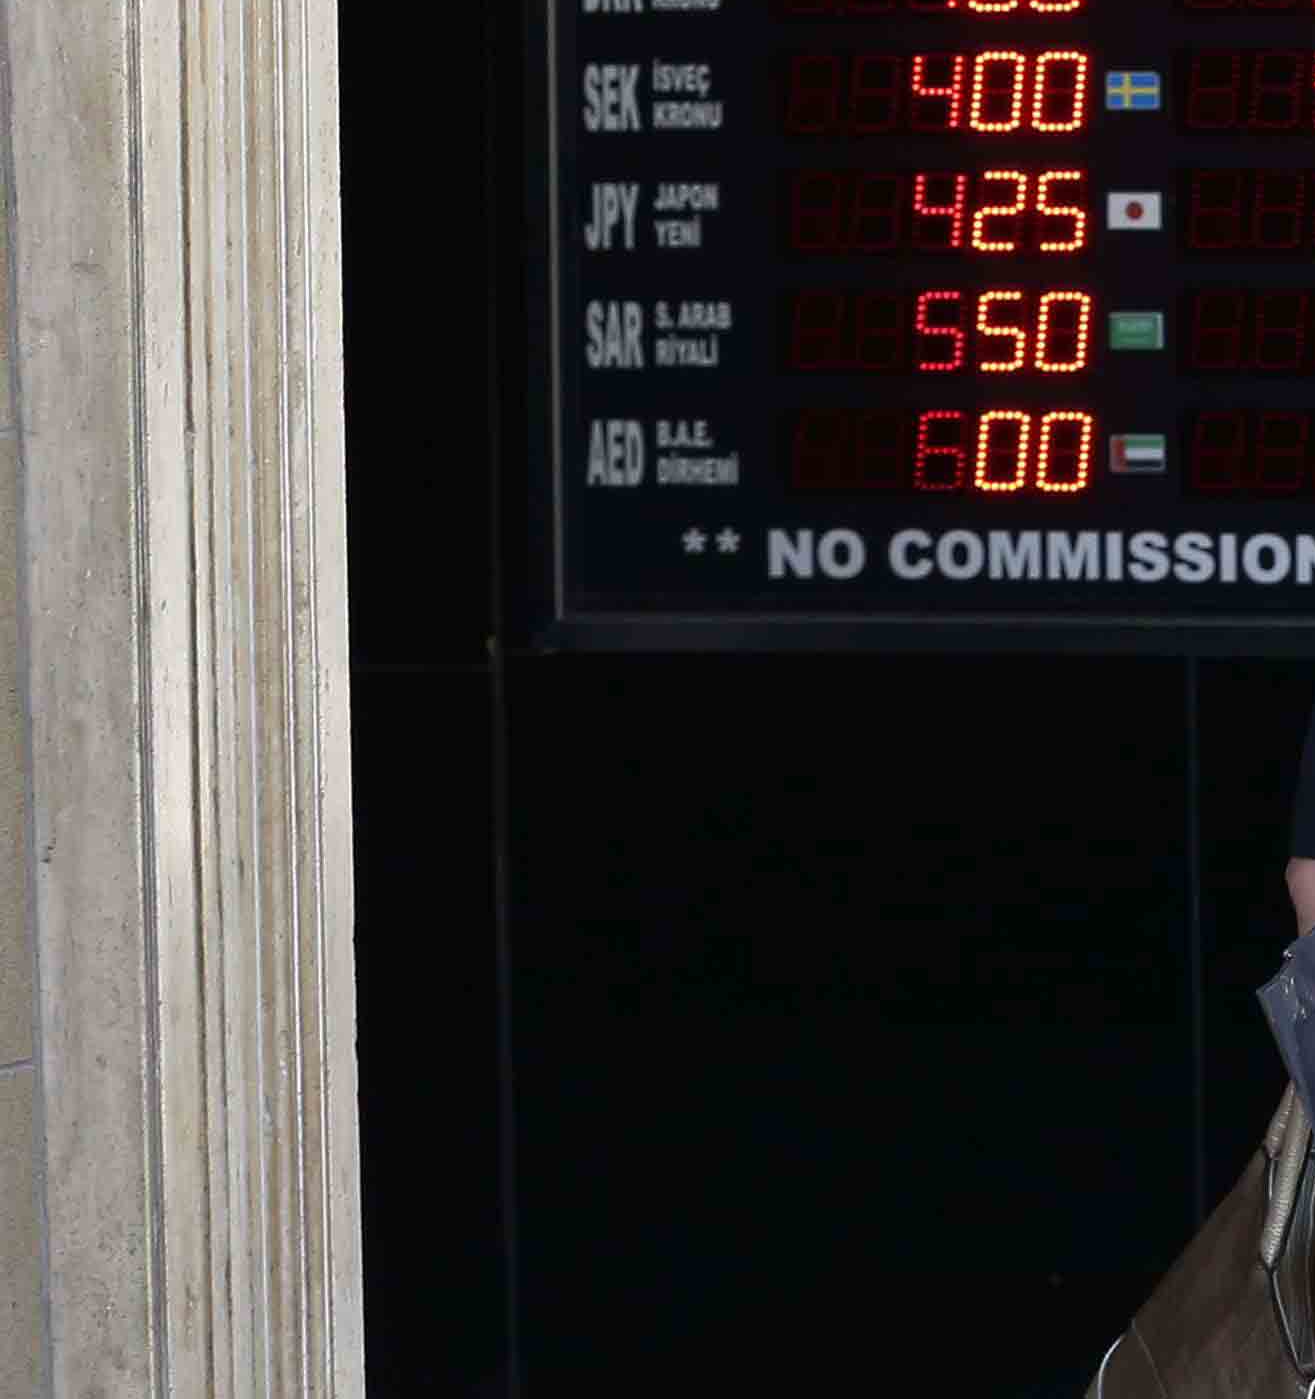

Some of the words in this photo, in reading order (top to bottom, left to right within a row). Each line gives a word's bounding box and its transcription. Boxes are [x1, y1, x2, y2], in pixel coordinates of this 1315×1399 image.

[583, 63, 641, 132] SEK
[652, 60, 710, 97] İSVEÇ
[911, 50, 1089, 133] 400
[652, 101, 723, 129] KRONU
[584, 182, 639, 250] JPY
[653, 183, 719, 211] JAPON
[913, 169, 1088, 252] 425
[654, 215, 701, 247] YENİ
[586, 300, 644, 369] SAR
[655, 301, 674, 329] S.
[677, 301, 732, 329] ARAB
[915, 289, 1092, 373] 550
[587, 419, 644, 486] AED
[656, 420, 713, 449] B.A.E.
[914, 407, 1097, 494] 600
[767, 528, 866, 579] NO
